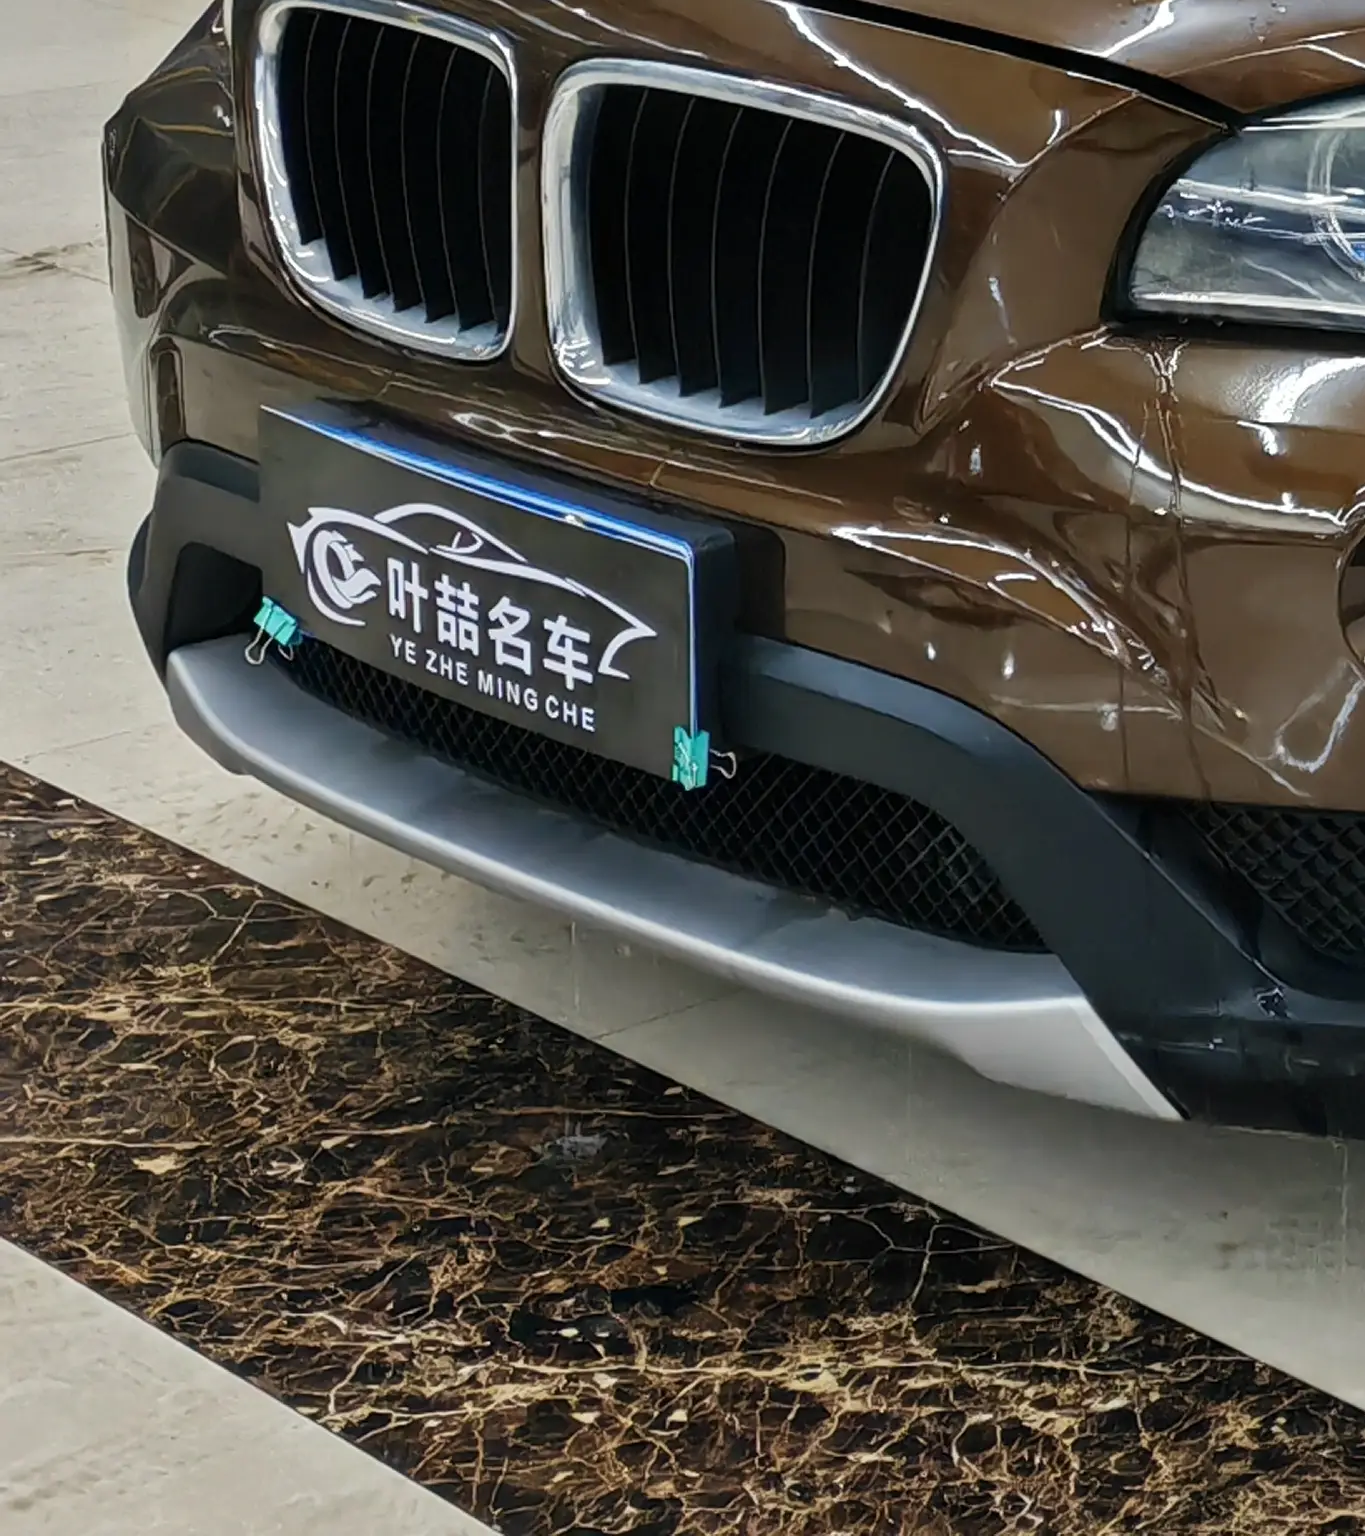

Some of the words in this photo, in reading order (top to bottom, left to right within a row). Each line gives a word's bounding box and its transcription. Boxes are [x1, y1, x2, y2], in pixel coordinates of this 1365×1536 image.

[386, 557, 596, 691] 叶喆名车
[389, 633, 417, 665] YE
[425, 649, 470, 686] ZHE
[477, 670, 539, 712] MING
[544, 697, 597, 733] CHE
